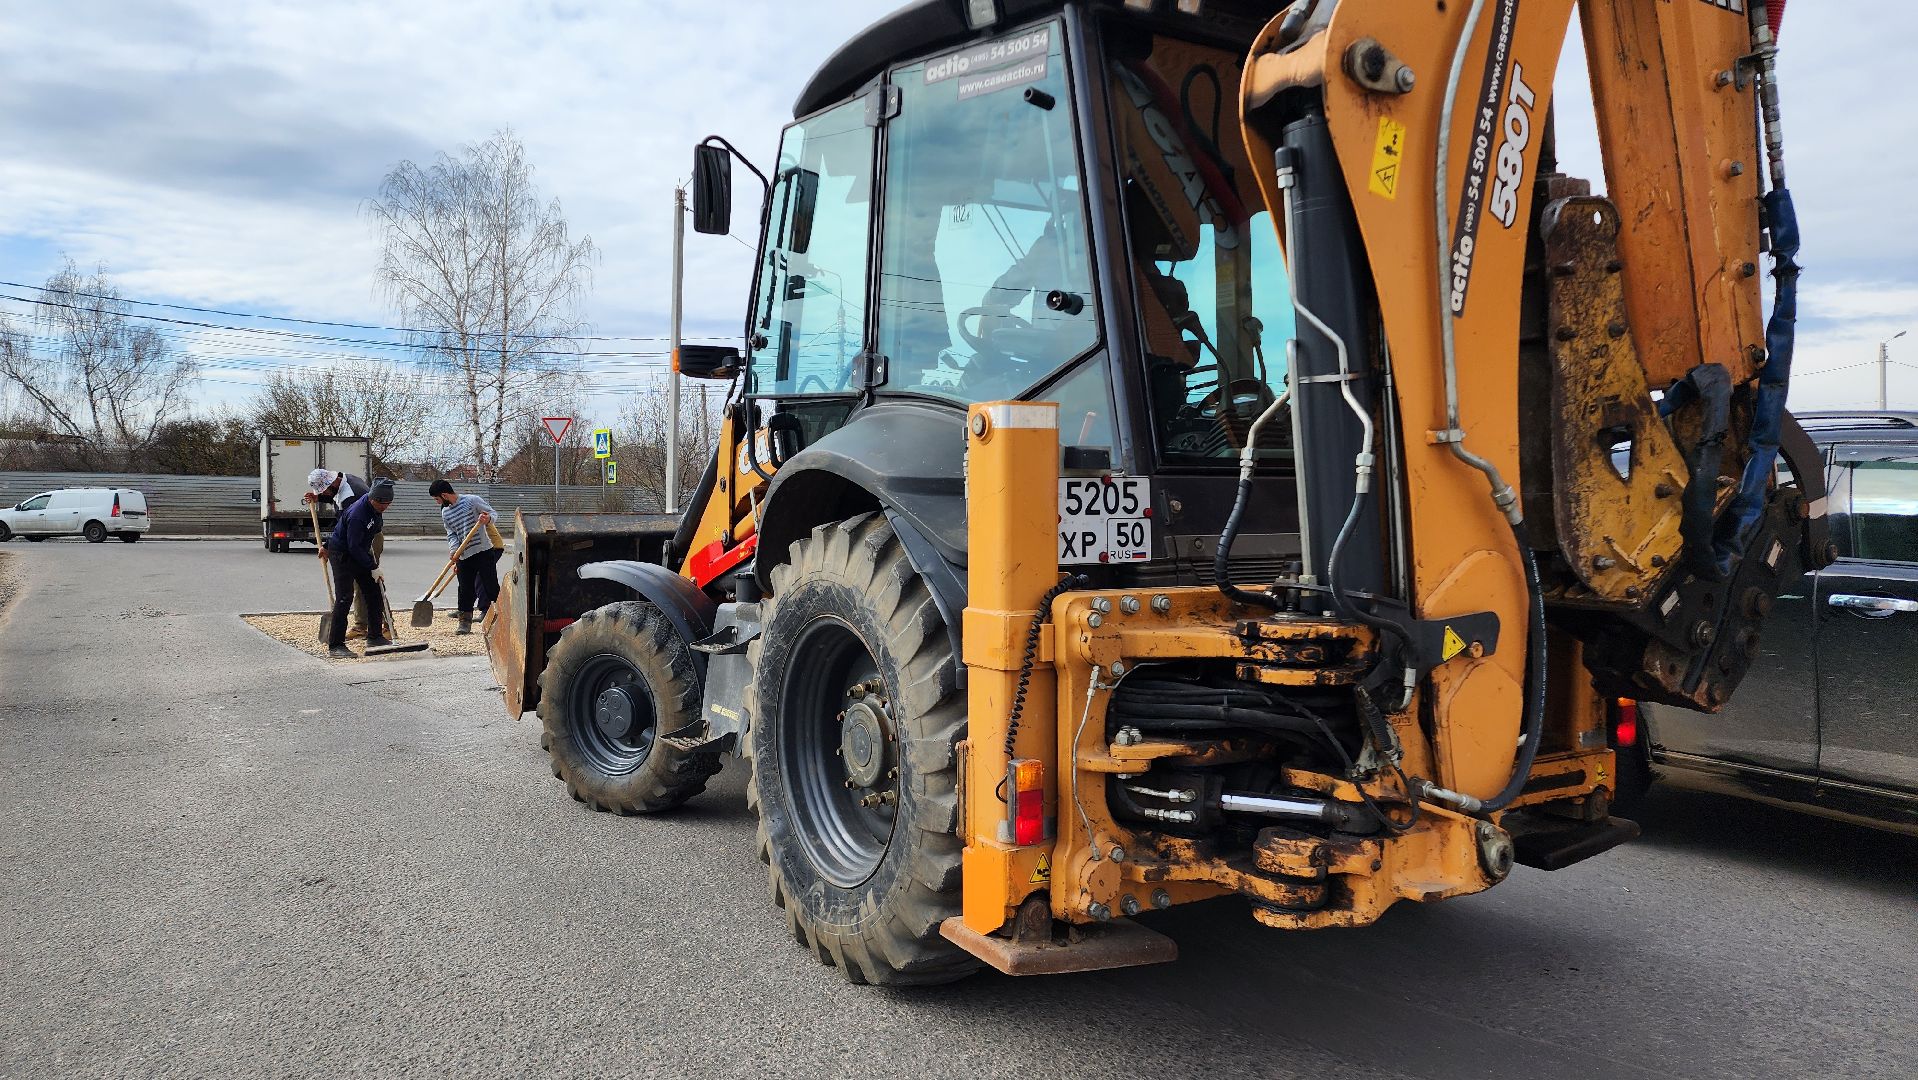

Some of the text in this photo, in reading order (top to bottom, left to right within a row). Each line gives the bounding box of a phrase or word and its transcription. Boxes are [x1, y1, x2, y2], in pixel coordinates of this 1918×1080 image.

[926, 32, 1048, 81] actio (495) 54 500 54
[959, 63, 1045, 94] www.caseactio.ru
[1479, 106, 1494, 133] 54
[1472, 134, 1488, 173] 500
[1490, 59, 1536, 229] 580T
[1467, 174, 1482, 201] 54
[1463, 202, 1477, 232] (495)
[1451, 235, 1474, 312] actio
[1065, 481, 1139, 515] 5205
[1116, 521, 1145, 547] 50
[1110, 550, 1131, 559] RUS
